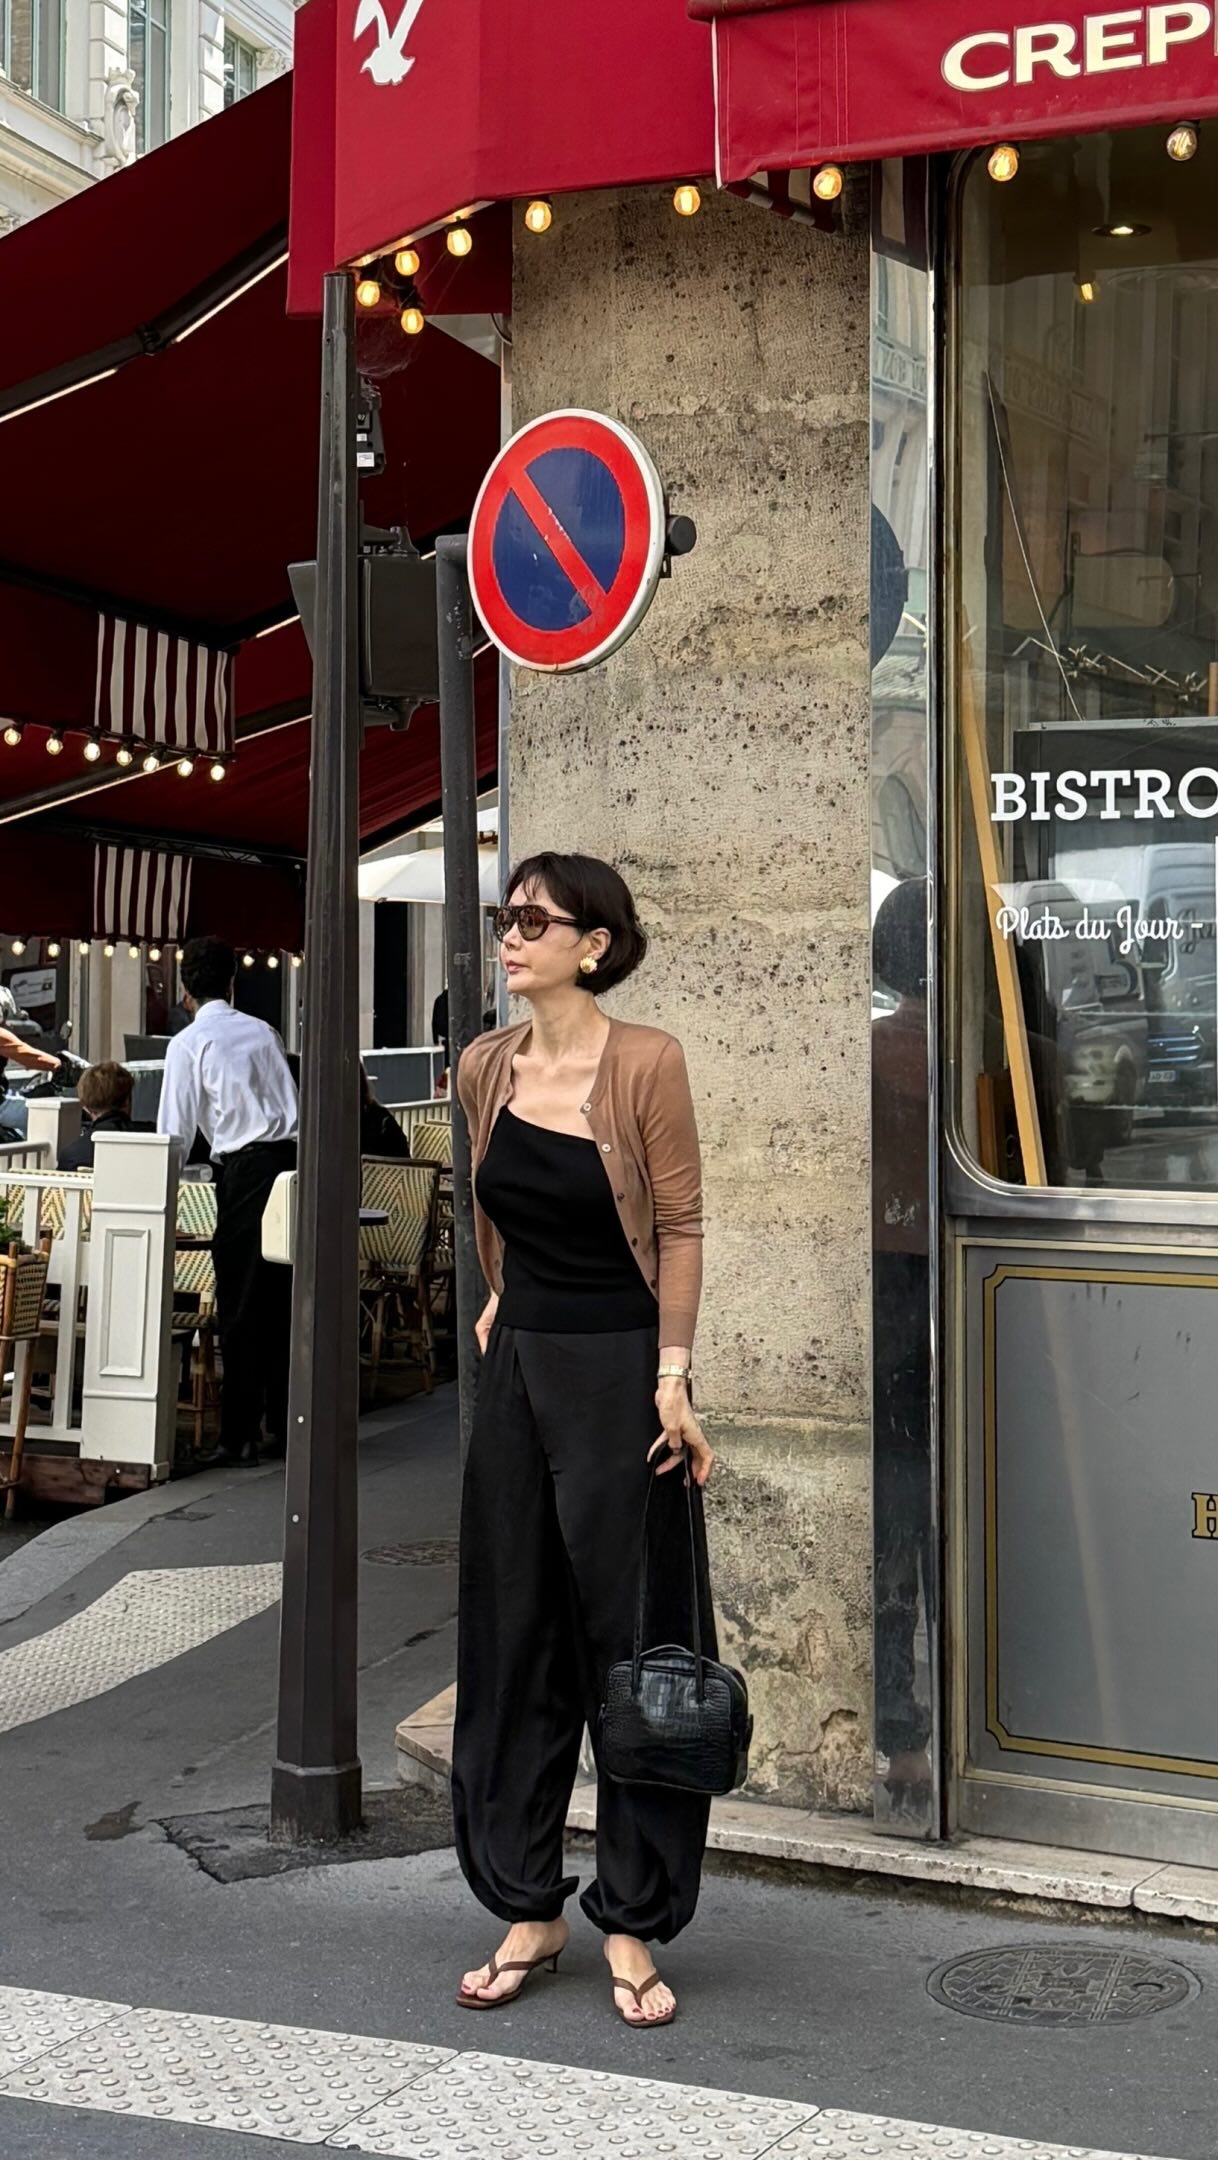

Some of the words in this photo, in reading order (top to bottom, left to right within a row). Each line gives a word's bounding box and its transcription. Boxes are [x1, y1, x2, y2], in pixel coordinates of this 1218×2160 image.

[940, 2, 1218, 92] CREP
[990, 767, 1218, 821] BISTRO
[995, 906, 1069, 941] Plats
[1075, 907, 1112, 941] du
[1116, 905, 1185, 955] Jour
